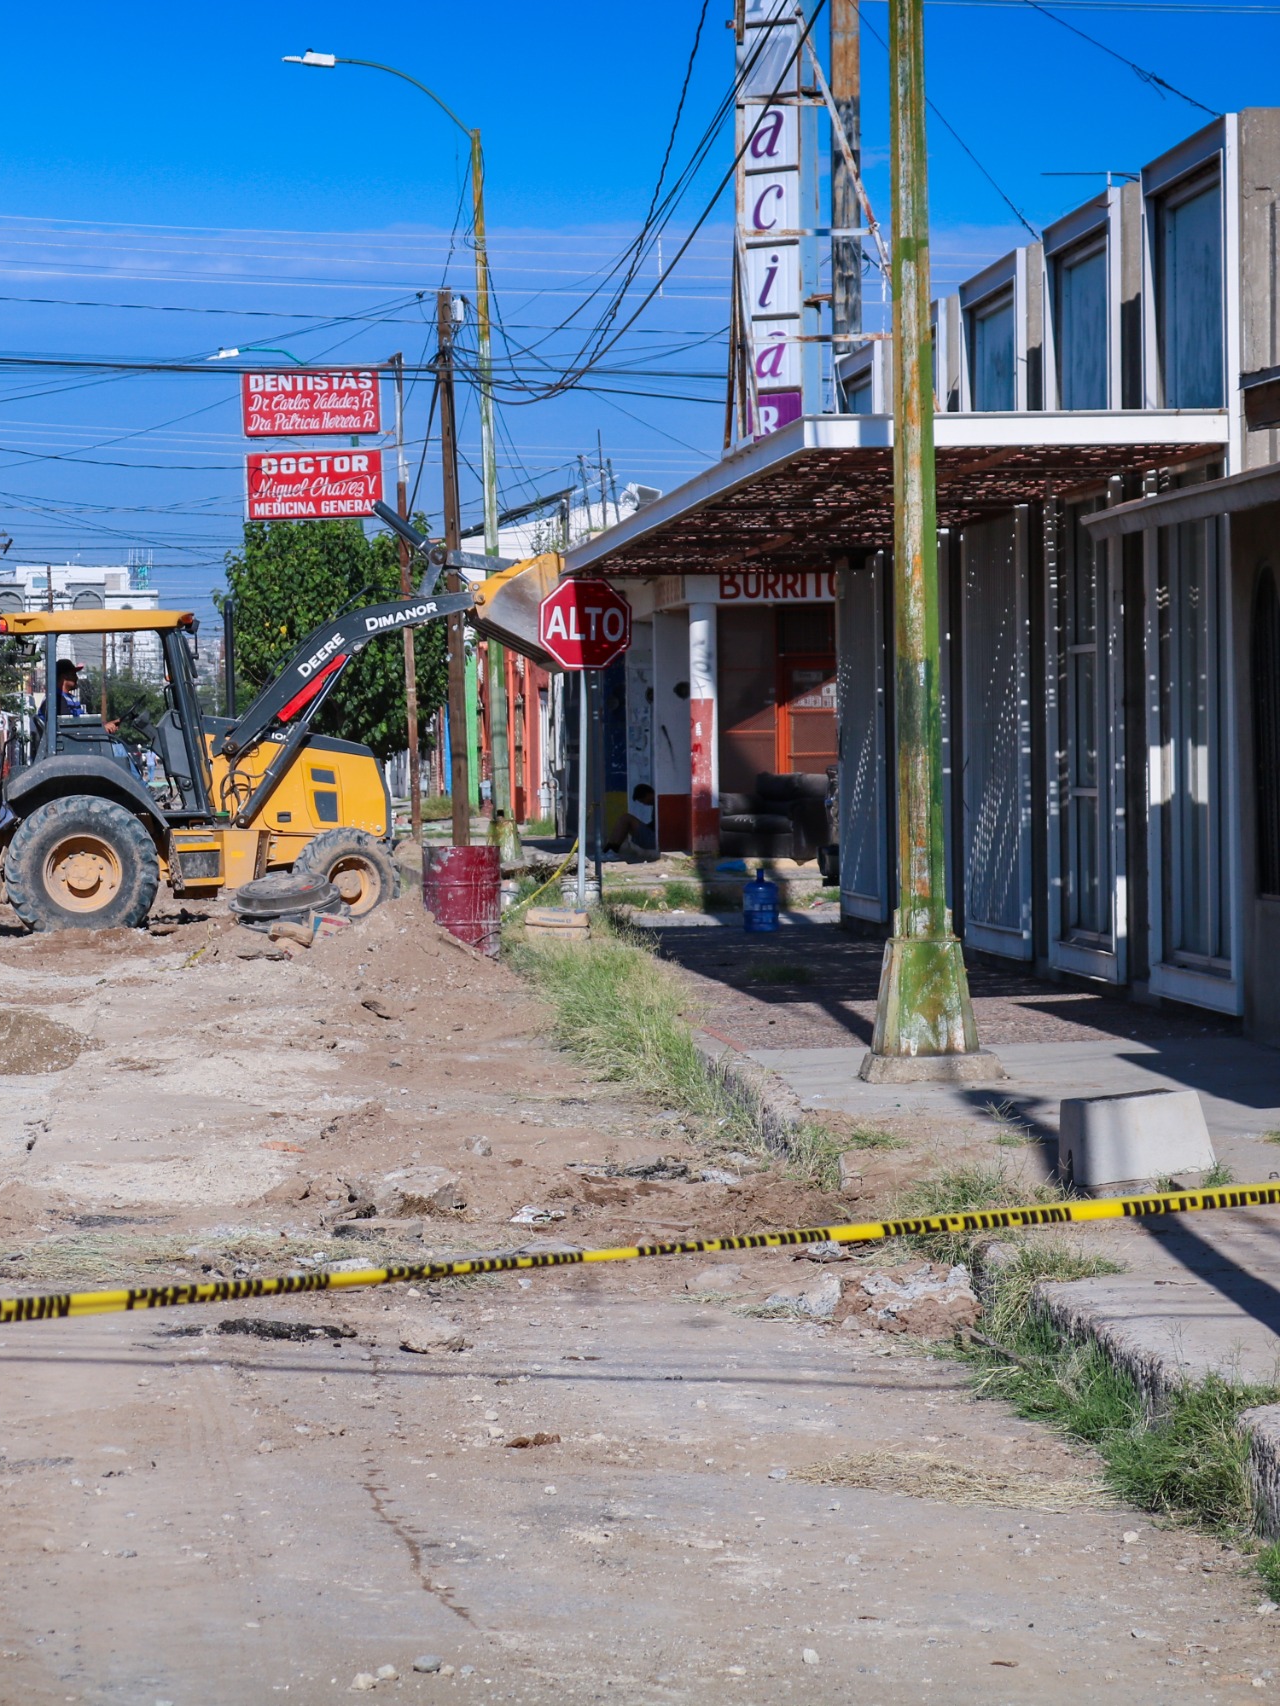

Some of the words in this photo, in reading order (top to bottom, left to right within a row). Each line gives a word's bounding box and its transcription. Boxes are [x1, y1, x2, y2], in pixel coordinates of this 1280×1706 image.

[249, 372, 373, 392] DENTISTAS
[248, 393, 269, 412] Dr.
[271, 393, 311, 411] Carlos
[313, 391, 359, 411] Valadez
[361, 390, 374, 408] R.
[274, 412, 320, 431] Patricia
[321, 410, 360, 429] Herrera
[362, 410, 376, 428] R.
[261, 455, 369, 475] DOCTOR
[309, 475, 364, 498] Chavez
[254, 501, 316, 516] MEDICINA
[365, 601, 438, 632] DIMANOR
[546, 606, 624, 641] ALTO
[297, 632, 345, 678] DEERE
